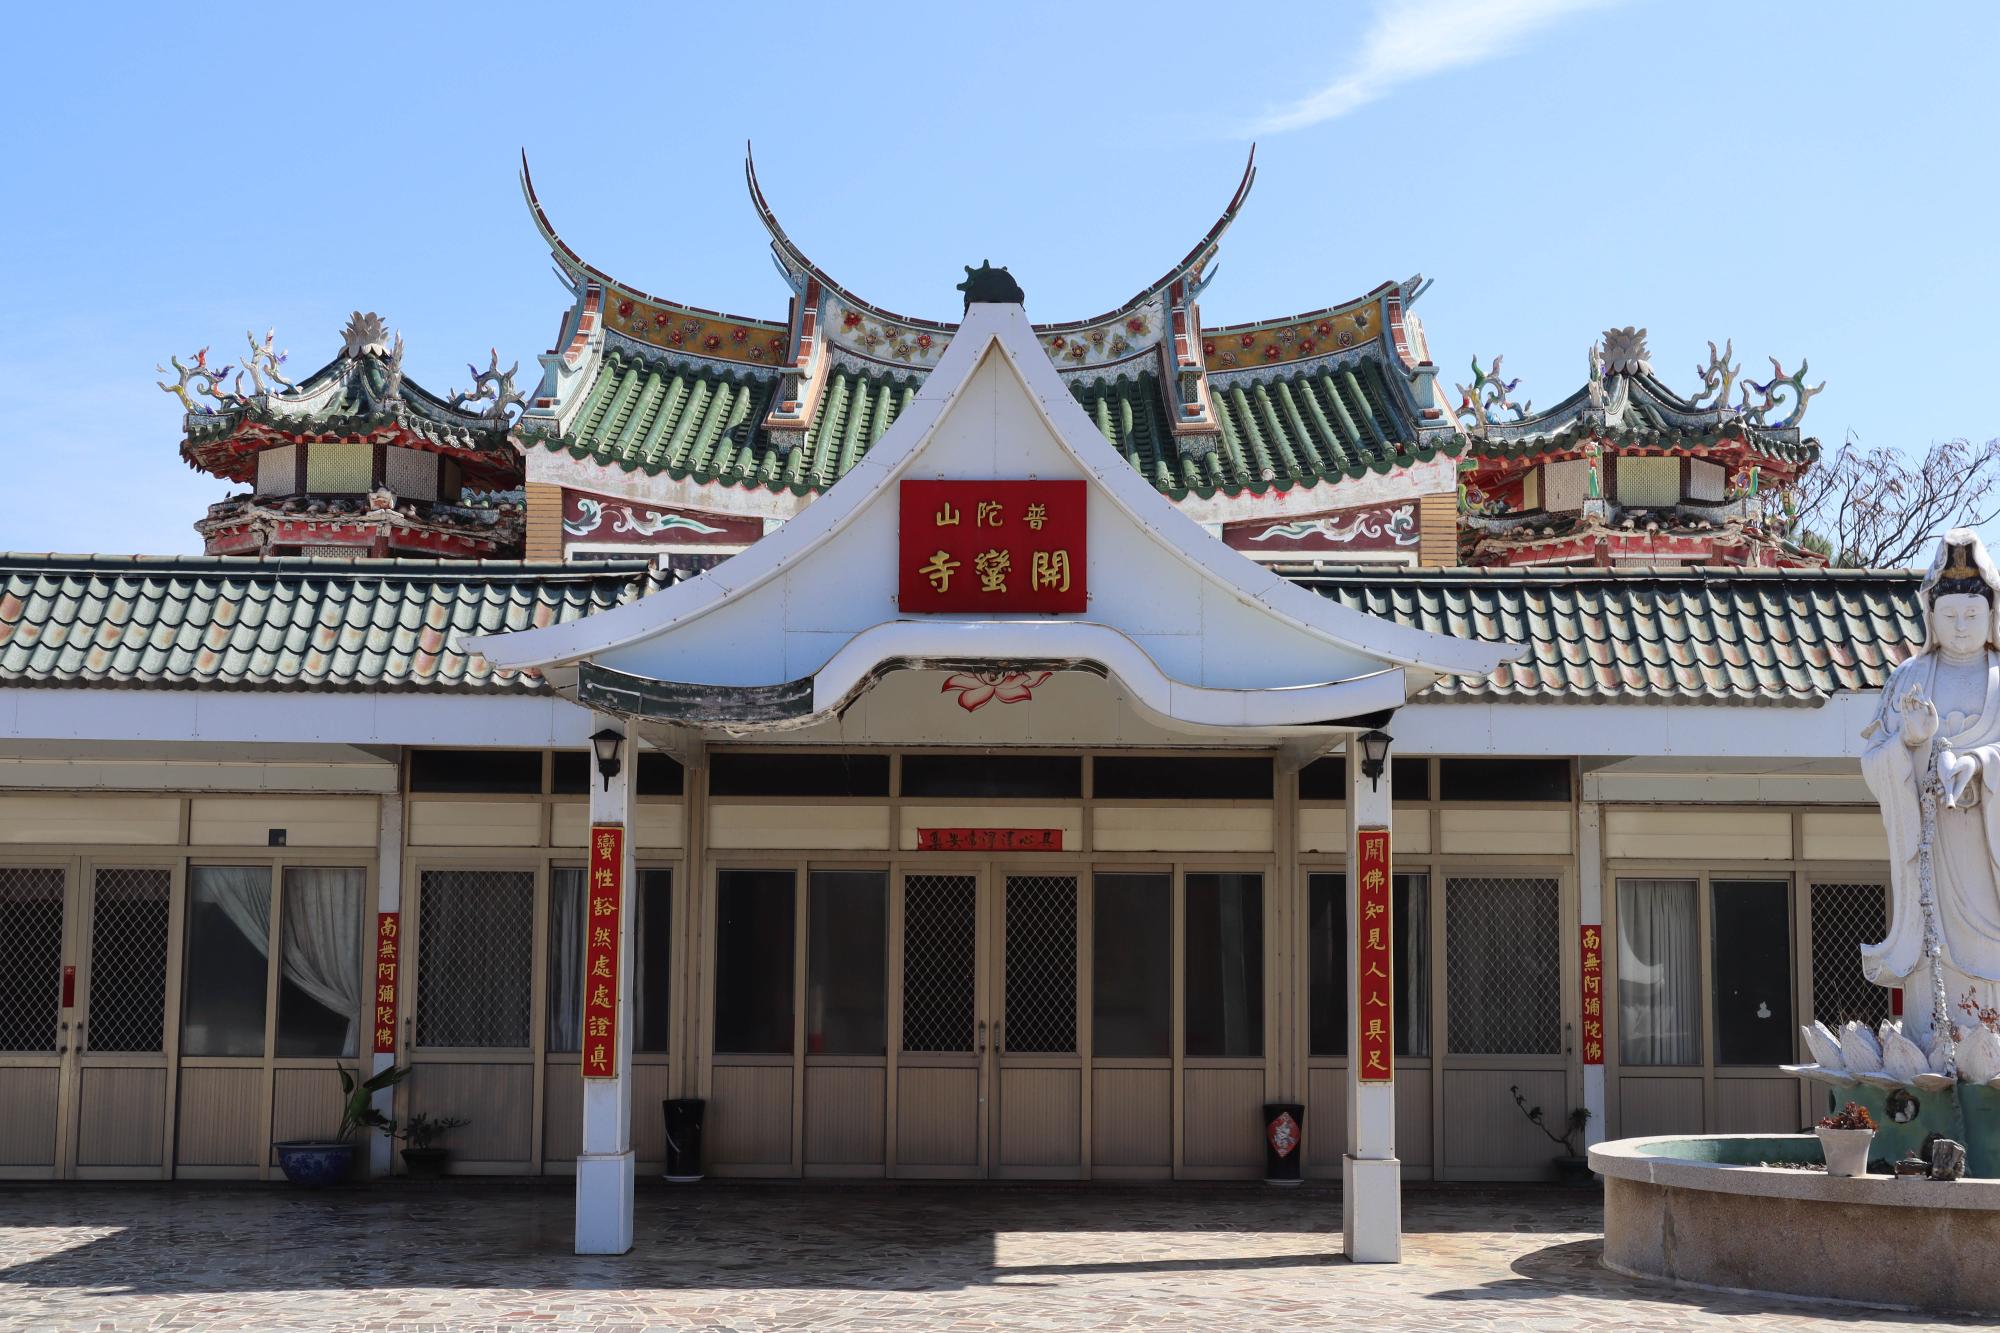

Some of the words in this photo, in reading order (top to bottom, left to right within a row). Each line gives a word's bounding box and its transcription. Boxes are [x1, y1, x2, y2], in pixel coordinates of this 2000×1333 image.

[376, 916, 397, 1047] 南無阿彌陀佛
[1583, 928, 1601, 1061] 南無阿彌陀佛
